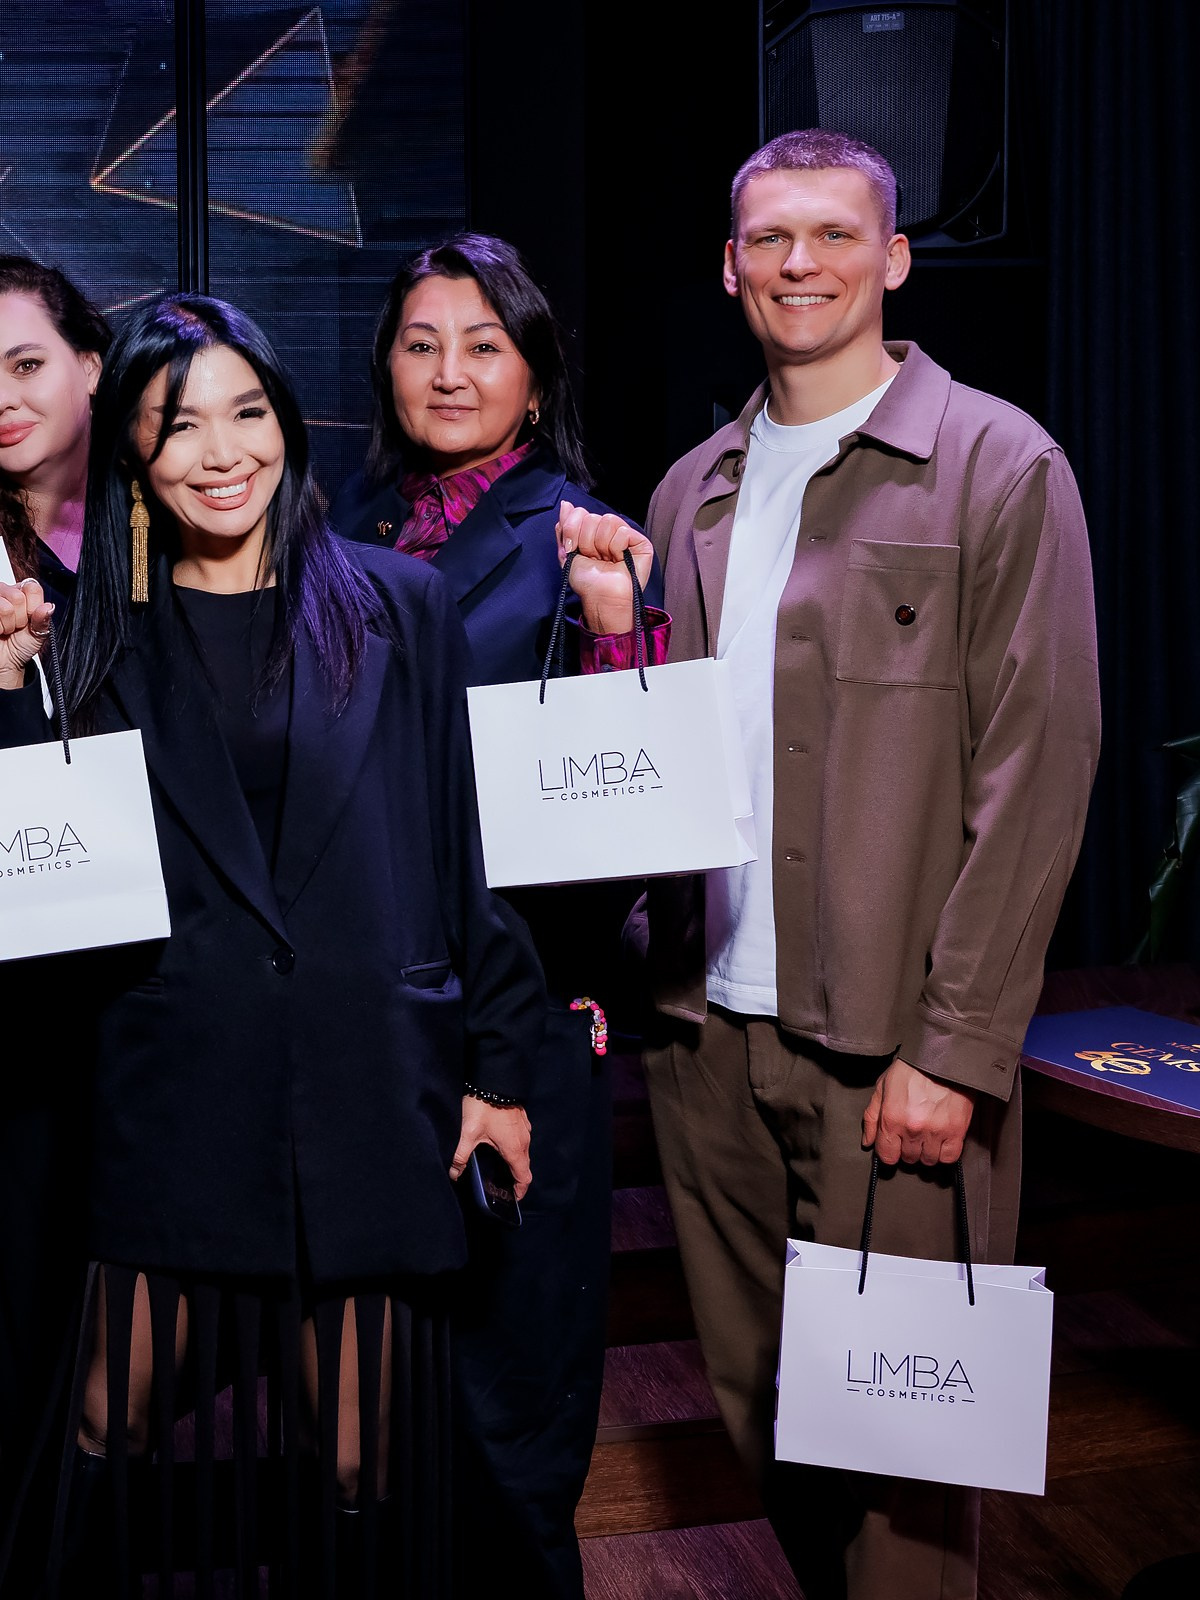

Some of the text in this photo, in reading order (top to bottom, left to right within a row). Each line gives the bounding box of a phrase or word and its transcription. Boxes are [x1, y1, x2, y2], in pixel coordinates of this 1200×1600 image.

[538, 748, 660, 791] LIMBA
[560, 785, 645, 801] COSMETICS
[847, 1349, 974, 1394] LIMBA
[866, 1388, 955, 1403] COSMETICS
